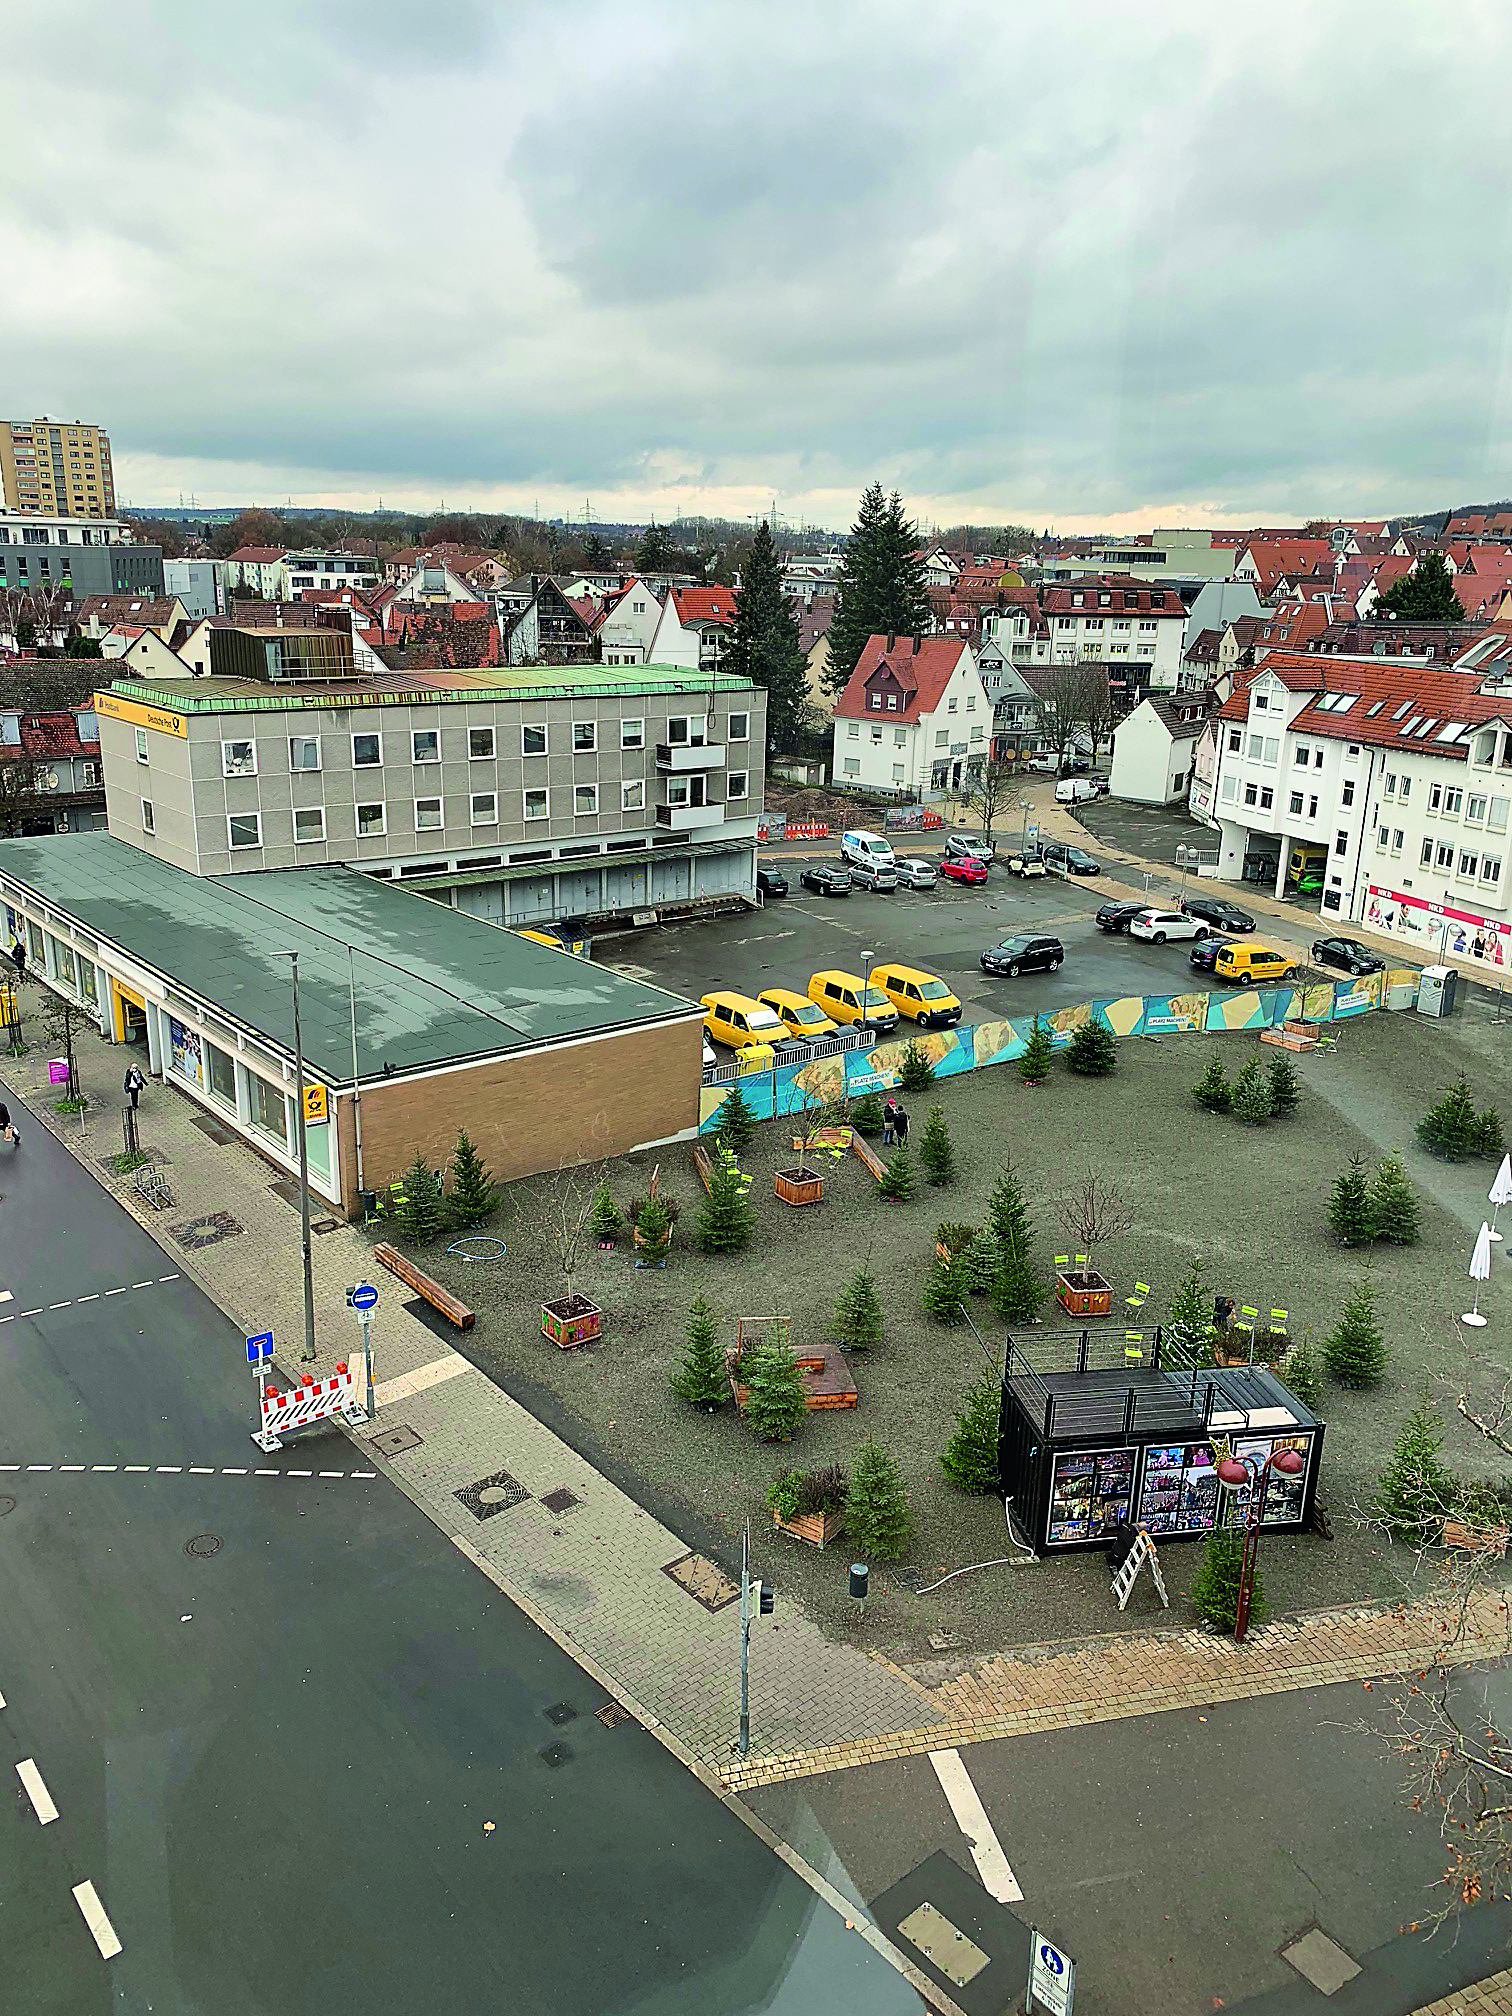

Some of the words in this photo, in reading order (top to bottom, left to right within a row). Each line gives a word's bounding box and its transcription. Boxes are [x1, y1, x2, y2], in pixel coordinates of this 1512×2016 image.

[104, 701, 120, 712] Postbank
[147, 714, 164, 726] Deutsche
[1377, 888, 1393, 899] NKD
[1428, 903, 1445, 914] NKD
[1483, 919, 1502, 931] NKD
[1042, 1965, 1060, 1984] ZONE
